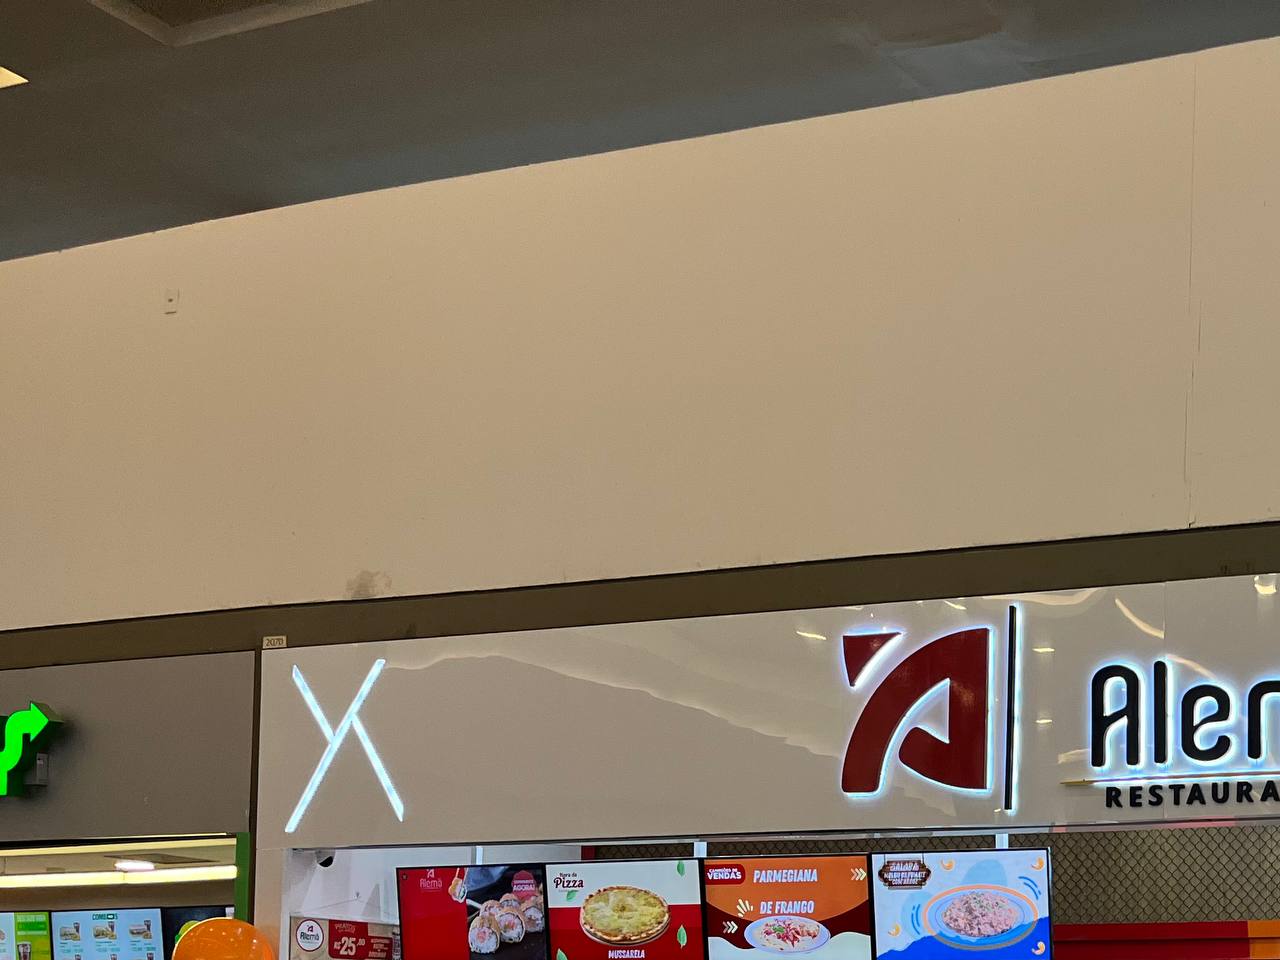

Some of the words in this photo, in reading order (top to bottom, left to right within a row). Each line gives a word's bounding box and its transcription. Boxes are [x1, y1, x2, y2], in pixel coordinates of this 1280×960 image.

[707, 872, 742, 880] VENDAS
[753, 869, 819, 883] PARMEGIANA
[553, 877, 584, 889] Pizza
[760, 901, 774, 914] DE
[775, 900, 815, 914] FRANGO
[608, 949, 645, 959] MUSSARELA
